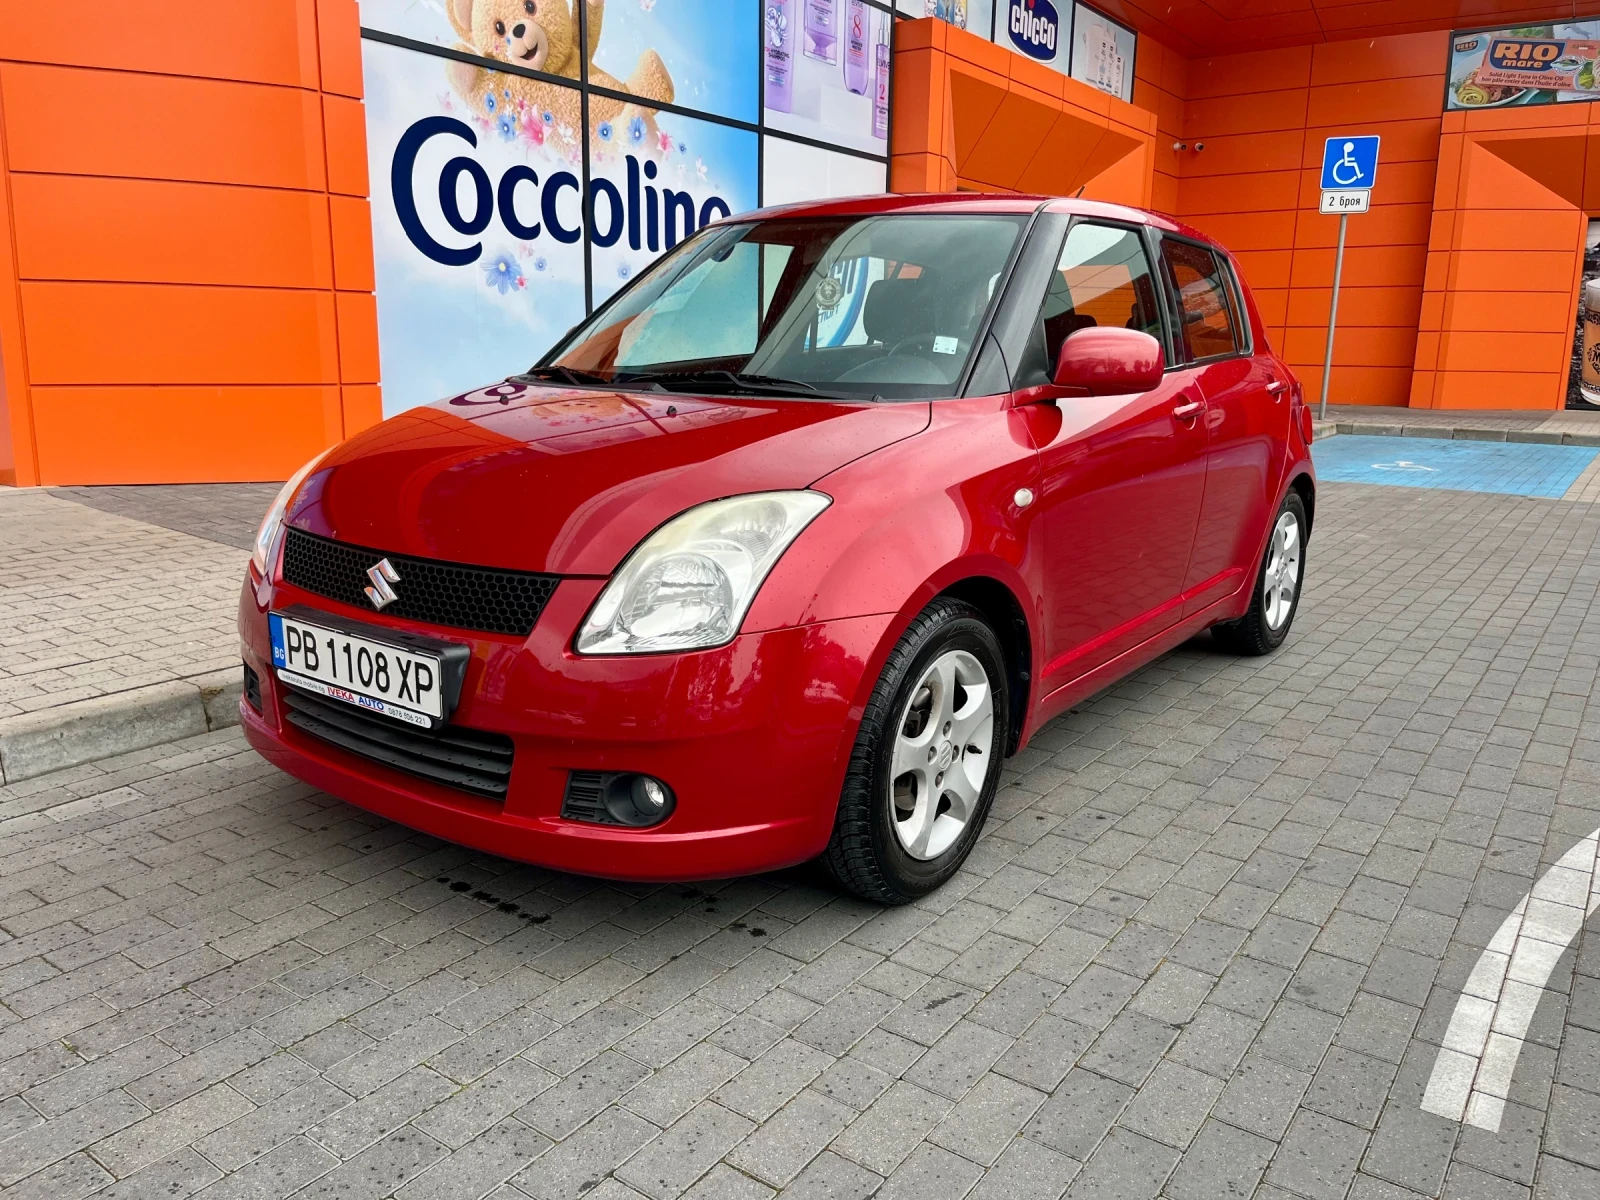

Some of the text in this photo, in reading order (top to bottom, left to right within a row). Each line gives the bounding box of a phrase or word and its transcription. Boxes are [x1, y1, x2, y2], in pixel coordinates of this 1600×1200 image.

[852, 14, 862, 39] 8
[1011, 0, 1056, 50] chicco
[1494, 43, 1559, 61] RIO
[1502, 59, 1543, 68] mare
[879, 83, 886, 100] 2
[1329, 195, 1361, 208] 2 броя
[274, 646, 285, 660] BG
[286, 625, 434, 705] PB 1108 XP
[327, 686, 355, 702] IVEKA
[359, 696, 385, 711] AUTO
